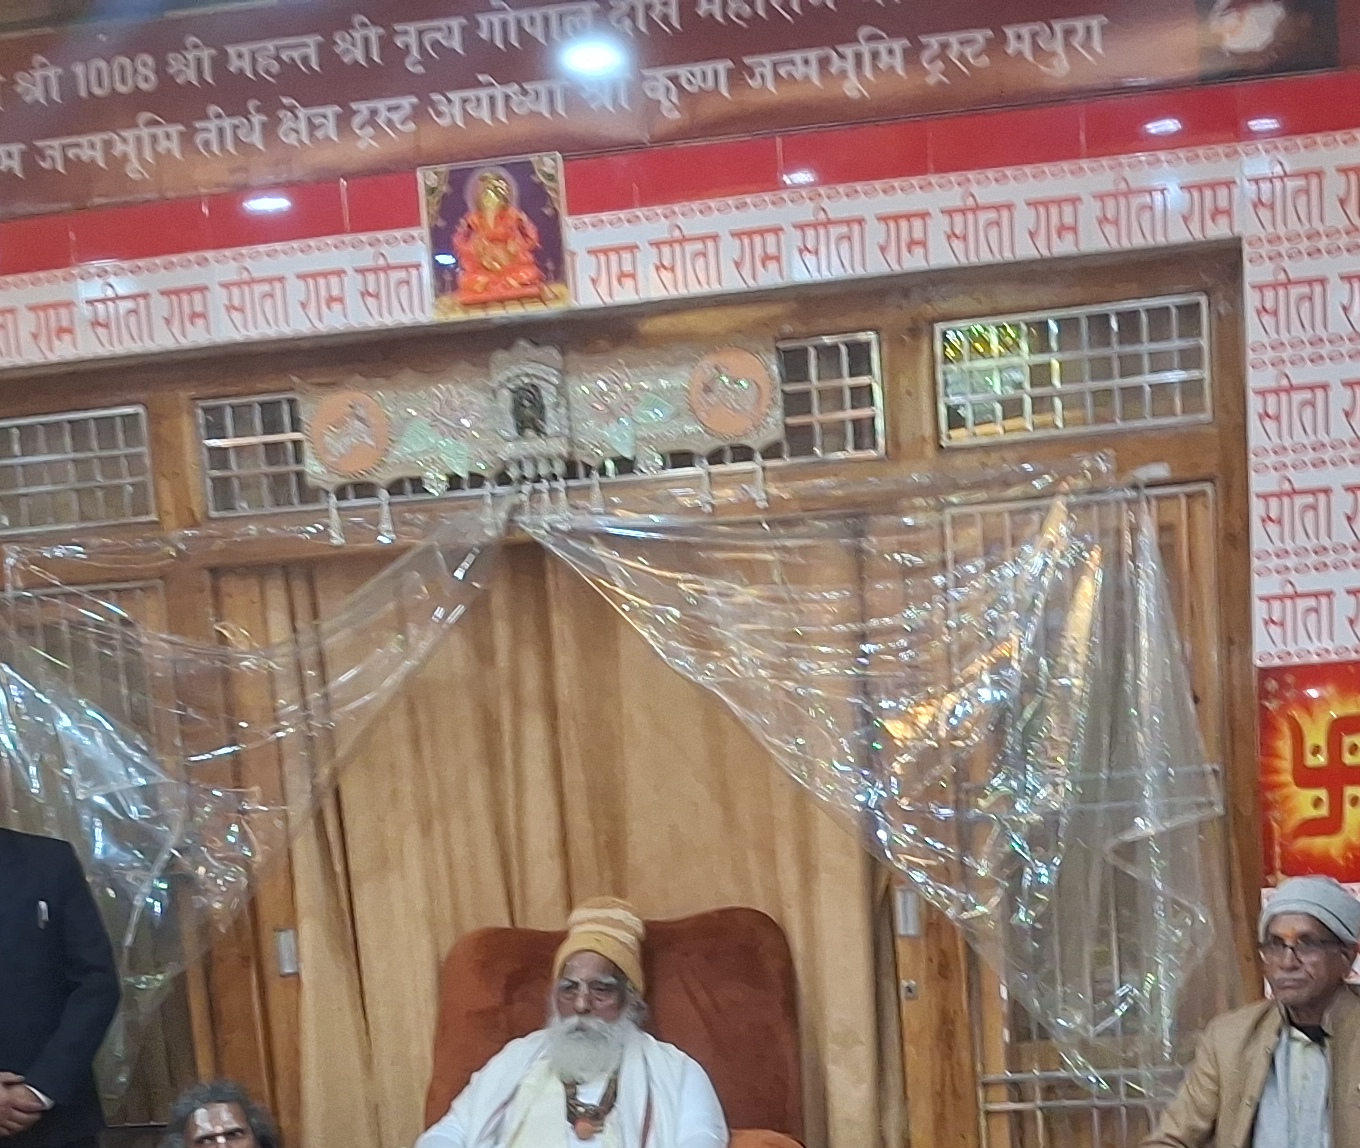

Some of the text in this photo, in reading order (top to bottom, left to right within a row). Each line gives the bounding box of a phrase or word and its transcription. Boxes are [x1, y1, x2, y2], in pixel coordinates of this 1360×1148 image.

[14, 53, 63, 105] श्री
[71, 53, 159, 98] 1008
[167, 33, 217, 88] श्री
[225, 33, 324, 84] महन्त
[333, 13, 385, 67] श्री
[393, 16, 466, 74] नृत्य
[35, 112, 186, 181] जन्मभूमि
[194, 99, 268, 158] तीर्थ
[277, 95, 343, 148] क्षेत्र
[429, 73, 570, 128] अयोध्या
[641, 58, 736, 119] कृष्ण
[742, 24, 911, 100] जन्मभूमि
[1002, 14, 1108, 76] मथुरा
[587, 242, 641, 304] राम
[648, 222, 724, 296] सीता
[730, 225, 786, 289] राम
[791, 205, 868, 280] सीता
[876, 210, 932, 272] राम
[940, 191, 1016, 266] सीता
[1024, 196, 1082, 257] राम
[1091, 175, 1169, 250] सीता
[1180, 179, 1240, 241] राम
[1247, 159, 1326, 233] सीता
[26, 300, 79, 361] राम
[85, 281, 156, 349] सीता
[158, 285, 212, 345] राम
[219, 265, 292, 335] सीता
[296, 269, 351, 330] राम
[354, 251, 429, 320] सीता
[1248, 264, 1331, 337] सीता
[1251, 370, 1332, 443] सीता
[1255, 473, 1334, 547] सीता
[1257, 578, 1336, 649] सीता
